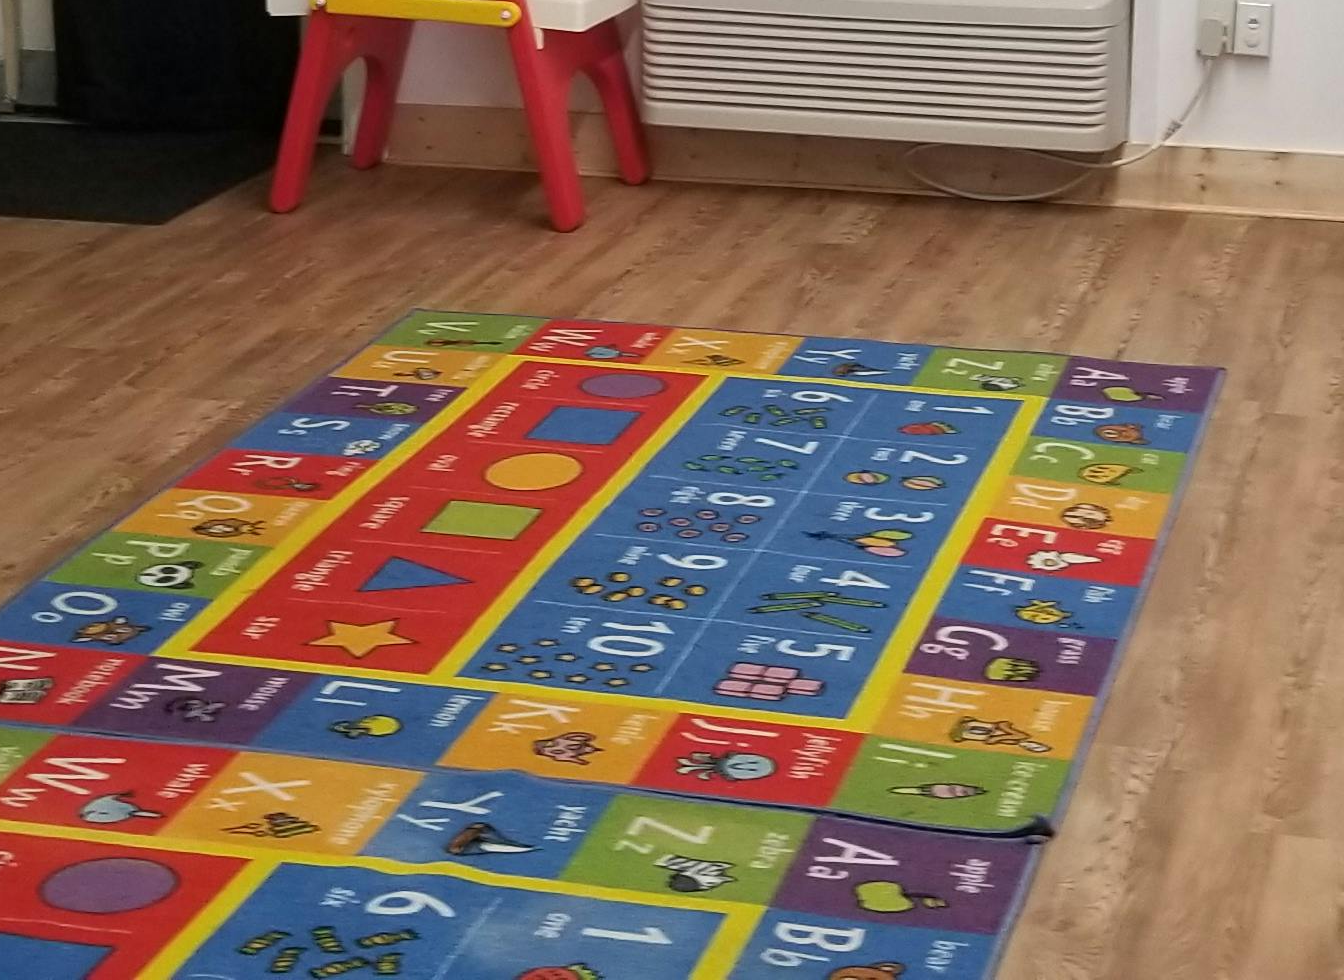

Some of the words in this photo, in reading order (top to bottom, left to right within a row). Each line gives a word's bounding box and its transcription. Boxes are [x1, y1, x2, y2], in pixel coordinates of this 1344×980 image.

[417, 320, 480, 335] Vv
[528, 328, 604, 353] Ww
[371, 350, 440, 369] Uu
[793, 348, 862, 365] Yy
[521, 369, 560, 391] circle
[1069, 366, 1131, 387] Aa
[330, 384, 399, 397] Tt
[790, 389, 854, 404] 6
[466, 401, 520, 438] rectangle
[932, 405, 995, 415] 1
[1051, 404, 1114, 426] Bb
[277, 417, 350, 435] Ss
[755, 437, 820, 455] 7
[898, 450, 969, 465] 2
[1029, 442, 1096, 464] Cc
[228, 454, 304, 476] Rr
[325, 461, 366, 477] ring
[427, 454, 460, 472] oval
[157, 495, 253, 520] Qq
[706, 491, 777, 508] 8
[1008, 483, 1078, 510] Dd
[359, 496, 411, 531] square
[828, 501, 865, 521] three
[863, 507, 935, 523] 3
[986, 524, 1060, 548] Ee
[1096, 539, 1126, 556] egg
[91, 540, 191, 565] Pp
[210, 547, 253, 576] panda
[617, 545, 653, 566] nine
[657, 552, 729, 571] 9
[291, 550, 355, 592] triangle
[788, 563, 824, 584] four
[819, 570, 892, 590] 4
[962, 570, 1036, 596] Ff
[32, 591, 118, 623] Oo
[1082, 585, 1116, 604] fish
[160, 602, 193, 622] owl
[241, 615, 281, 640] star
[560, 616, 593, 635] ten
[586, 620, 675, 658] 10
[737, 634, 777, 654] five
[774, 639, 856, 662] 5
[919, 625, 1008, 661] Gg
[1056, 637, 1088, 665] grass
[55, 658, 126, 706] notebook
[110, 663, 223, 710] Mm
[238, 677, 291, 711] mouse
[428, 694, 486, 728] lemon
[900, 682, 987, 720] Hh
[487, 699, 582, 734] Kk
[611, 713, 661, 746] kettle
[680, 718, 780, 748] Jj
[787, 732, 842, 780] jellyfish
[157, 763, 211, 799] whale
[209, 771, 312, 813] Xx
[395, 791, 505, 831] Yy
[542, 804, 588, 842] yacht
[613, 816, 714, 855] Zz
[749, 832, 796, 870] zebra
[805, 837, 900, 880] Aa
[949, 858, 995, 895] apple
[318, 887, 361, 909] six
[364, 890, 456, 919] 6
[533, 912, 572, 939] one
[581, 926, 674, 946] 1
[759, 921, 867, 968] Bb
[925, 939, 971, 973] bear
